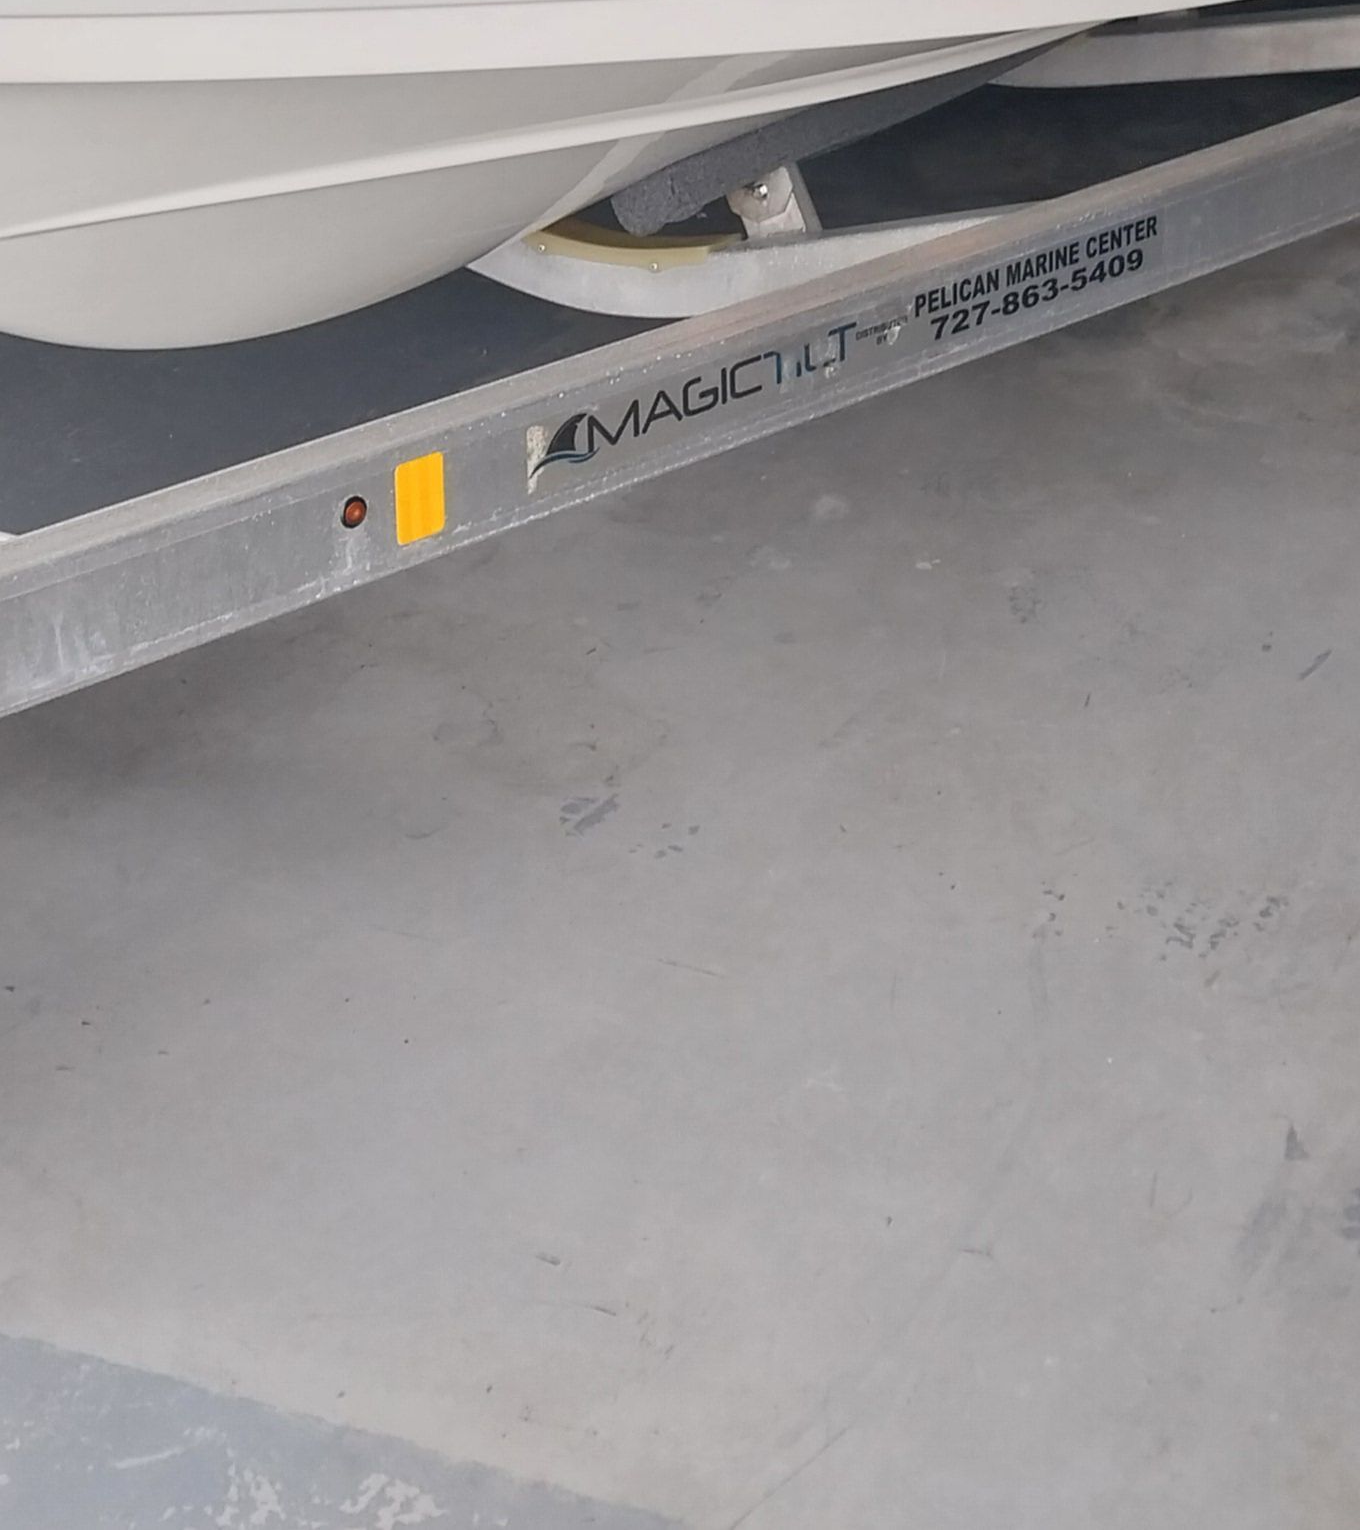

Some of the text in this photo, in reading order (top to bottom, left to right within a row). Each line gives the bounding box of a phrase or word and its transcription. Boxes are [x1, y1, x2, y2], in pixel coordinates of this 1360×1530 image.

[914, 215, 1158, 318] PELICAN MARINE CENTER
[930, 248, 1143, 340] 727-863-5409
